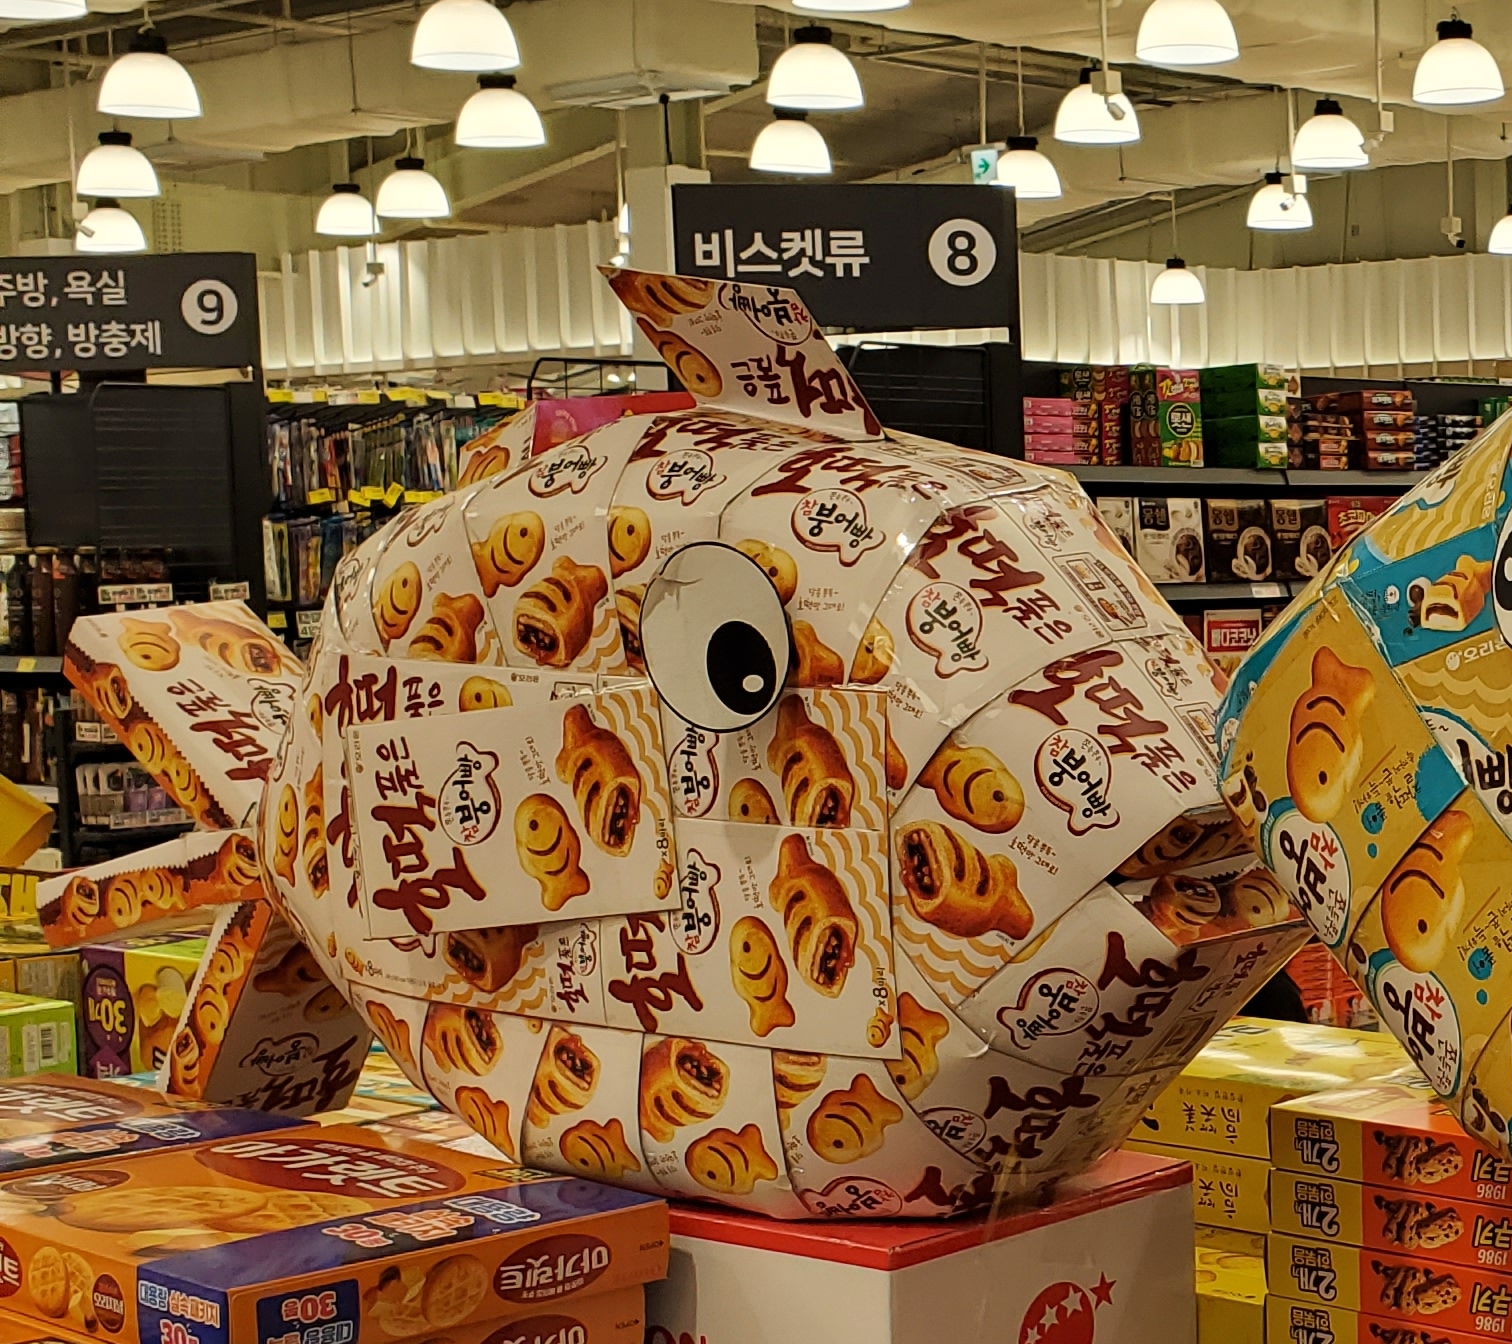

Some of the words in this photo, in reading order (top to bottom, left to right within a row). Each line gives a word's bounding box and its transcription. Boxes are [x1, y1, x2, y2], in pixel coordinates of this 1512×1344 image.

[694, 228, 870, 278] 비스켓류
[947, 230, 978, 277] 8
[64, 270, 128, 307] 욕실
[195, 289, 217, 325] 9
[68, 319, 161, 357] 방충제
[499, 1245, 609, 1290] 마가렛트
[1477, 1249, 1508, 1266] 1986
[1475, 1315, 1507, 1332] 1986
